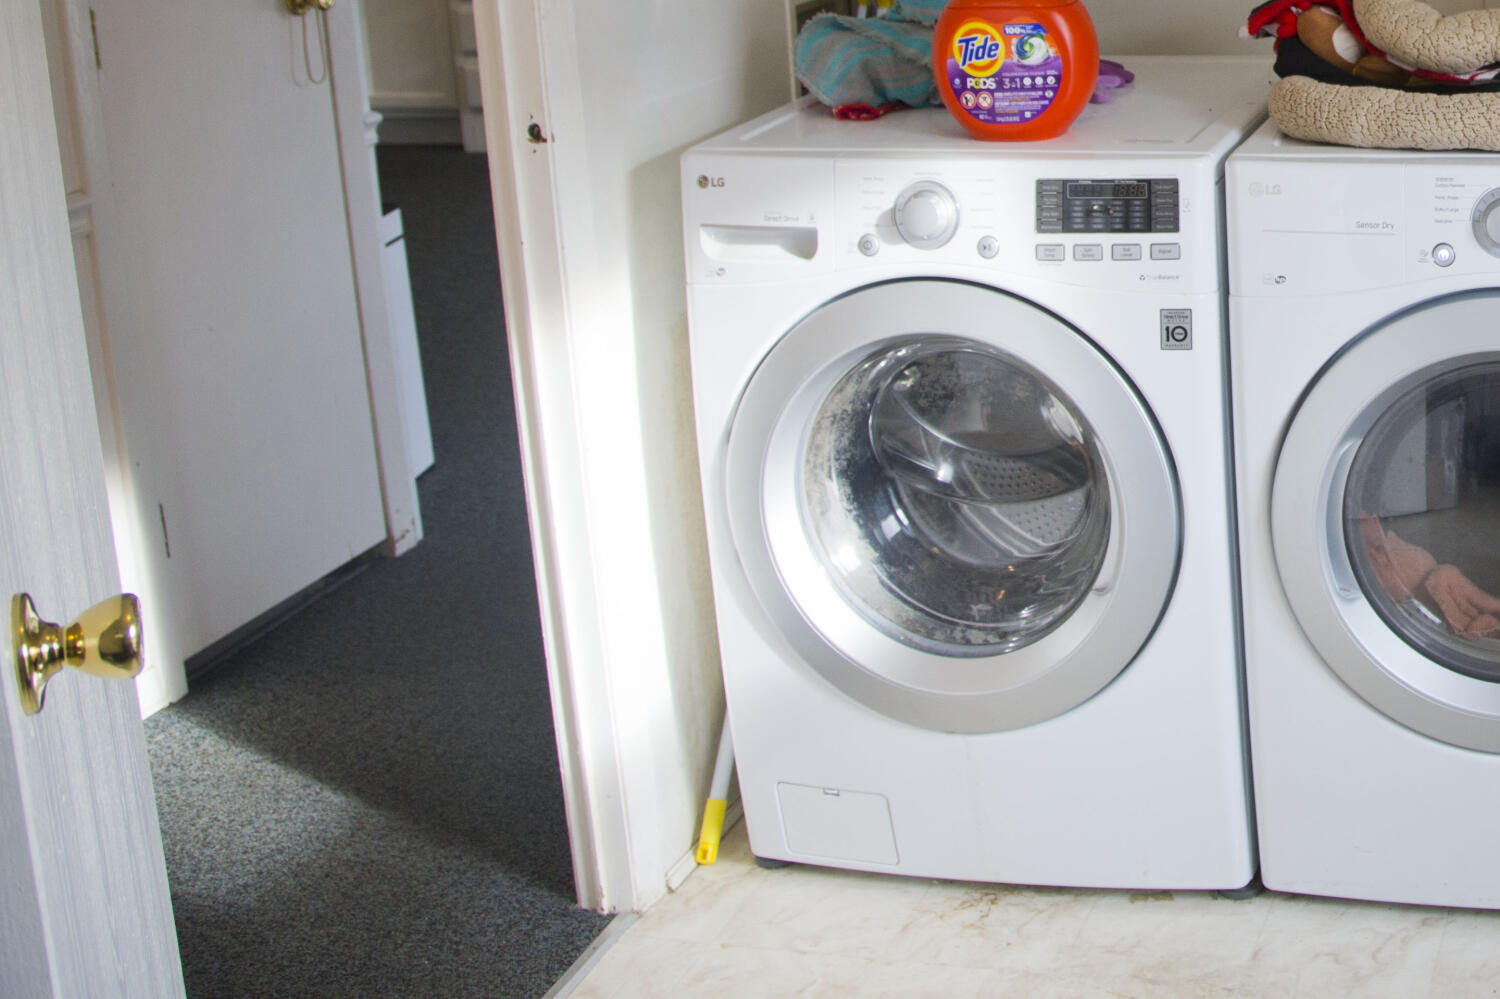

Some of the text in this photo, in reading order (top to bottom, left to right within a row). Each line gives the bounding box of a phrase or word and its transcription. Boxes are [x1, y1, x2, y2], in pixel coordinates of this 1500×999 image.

[957, 36, 1000, 67] Tide
[966, 77, 997, 89] PODS
[1355, 221, 1395, 231] Sensor Dry
[1165, 325, 1188, 343] 10
